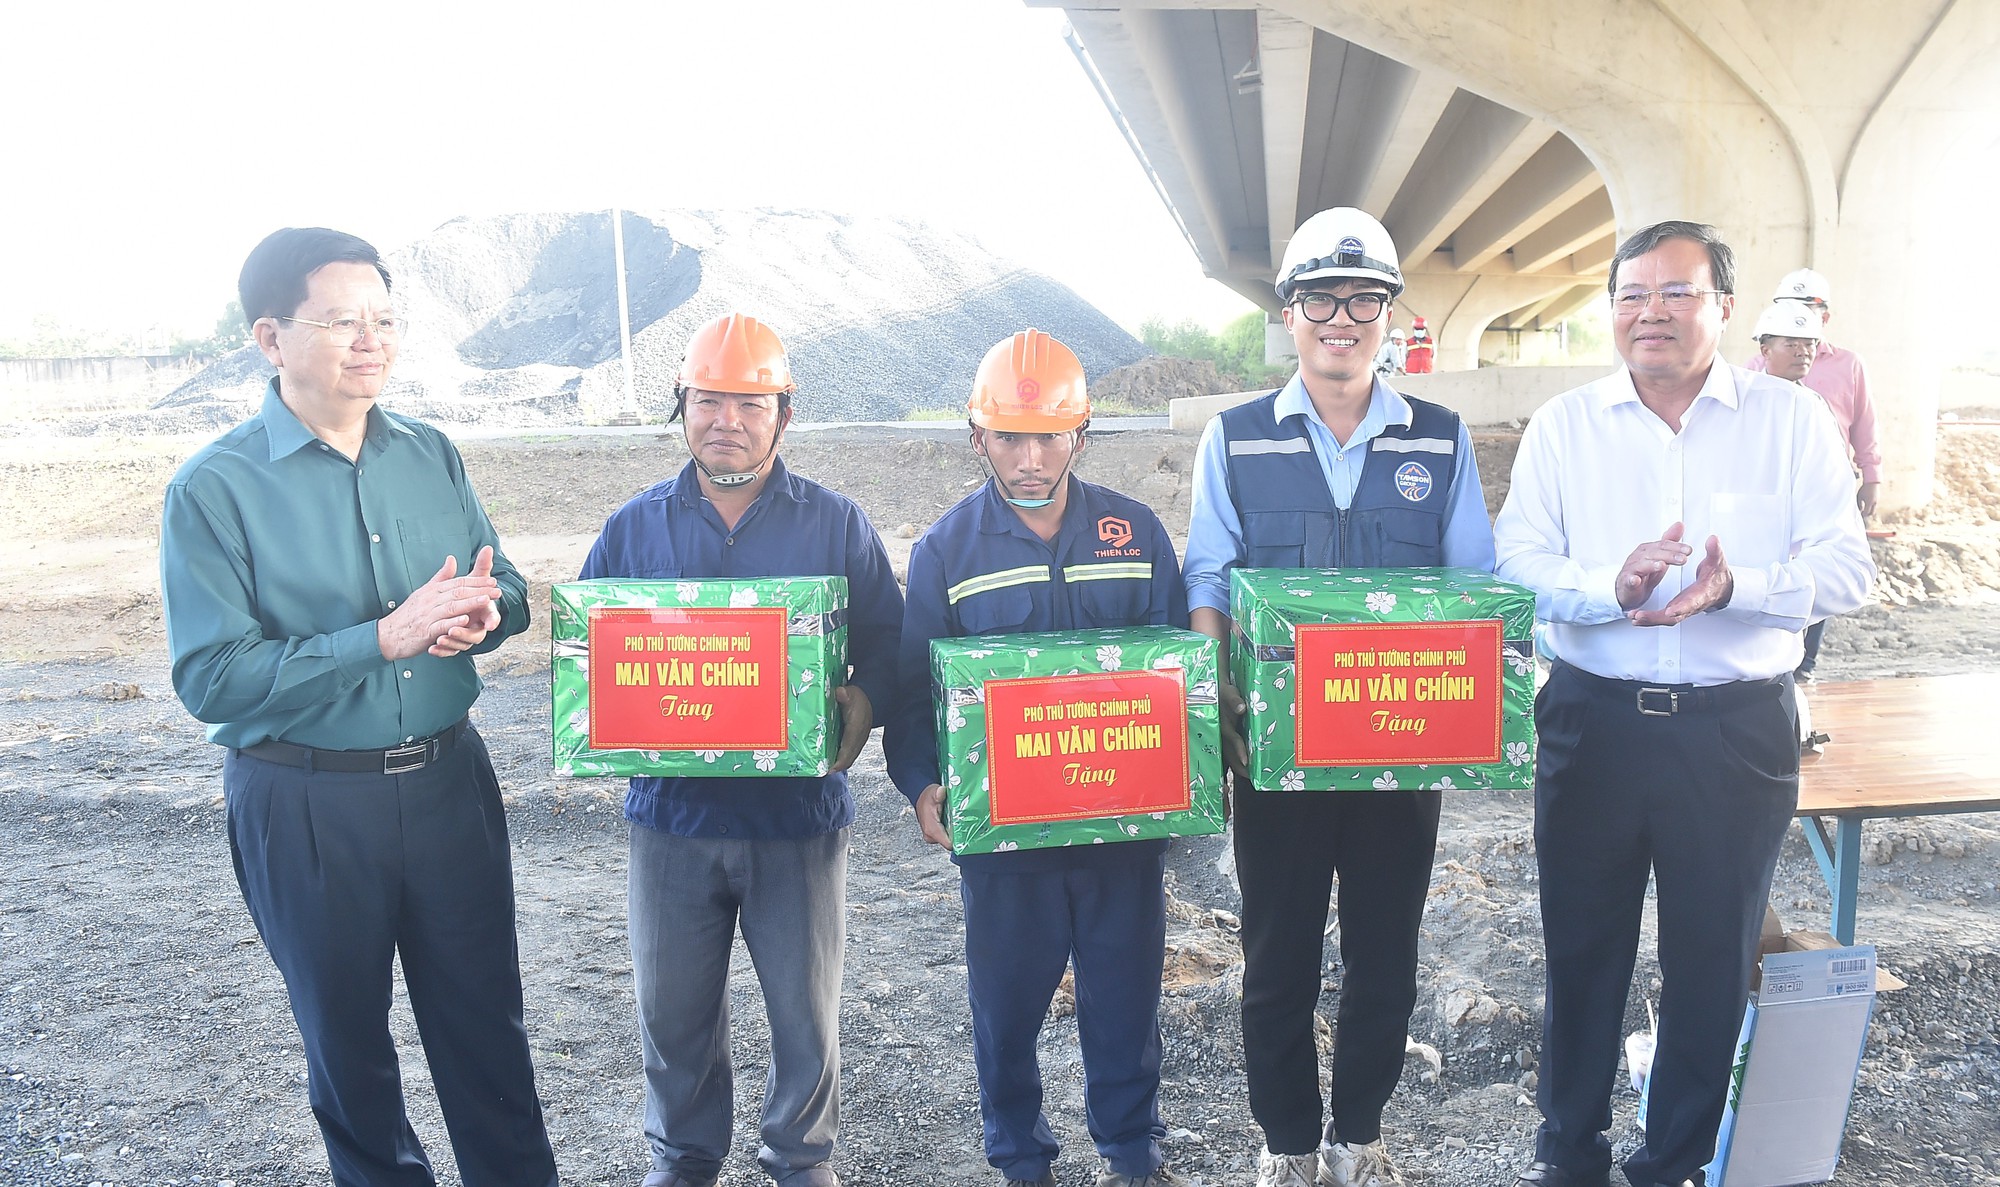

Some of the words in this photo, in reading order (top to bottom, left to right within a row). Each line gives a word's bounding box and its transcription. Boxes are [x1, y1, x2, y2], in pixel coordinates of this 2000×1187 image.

[1398, 474, 1430, 484] TAMSON
[1094, 549, 1122, 558] THIEN
[1124, 548, 1141, 556] LOC
[624, 632, 644, 652] PHÓ
[645, 631, 665, 652] THỦ
[665, 632, 698, 652] TƯỚNG
[697, 632, 729, 652] CHÍNH
[730, 631, 751, 652] PHỦ
[1334, 649, 1355, 668] PHÓ
[1356, 646, 1376, 668] THỦ
[1377, 648, 1411, 667] TƯỚNG
[1412, 647, 1444, 667] CHÍNH
[1445, 645, 1466, 666] PHỦ
[615, 662, 650, 686] MAI
[655, 657, 695, 687] VĂN
[701, 656, 760, 687] CHÍNH
[1324, 678, 1360, 703] MAI
[1366, 672, 1407, 702] VĂN
[1414, 671, 1475, 702] CHÍNH
[659, 694, 715, 721] Tặng
[1023, 702, 1044, 723] PHÓ
[1045, 699, 1064, 721] THỦ
[1065, 699, 1098, 720] TƯỚNG
[1099, 697, 1130, 717] CHÍNH
[1131, 693, 1151, 715] PHỦ
[1370, 710, 1427, 736] Tặng
[1015, 731, 1052, 759] MAI
[1056, 724, 1096, 755] VĂN
[1102, 719, 1161, 752] CHÍNH
[1062, 762, 1118, 788] Tặng
